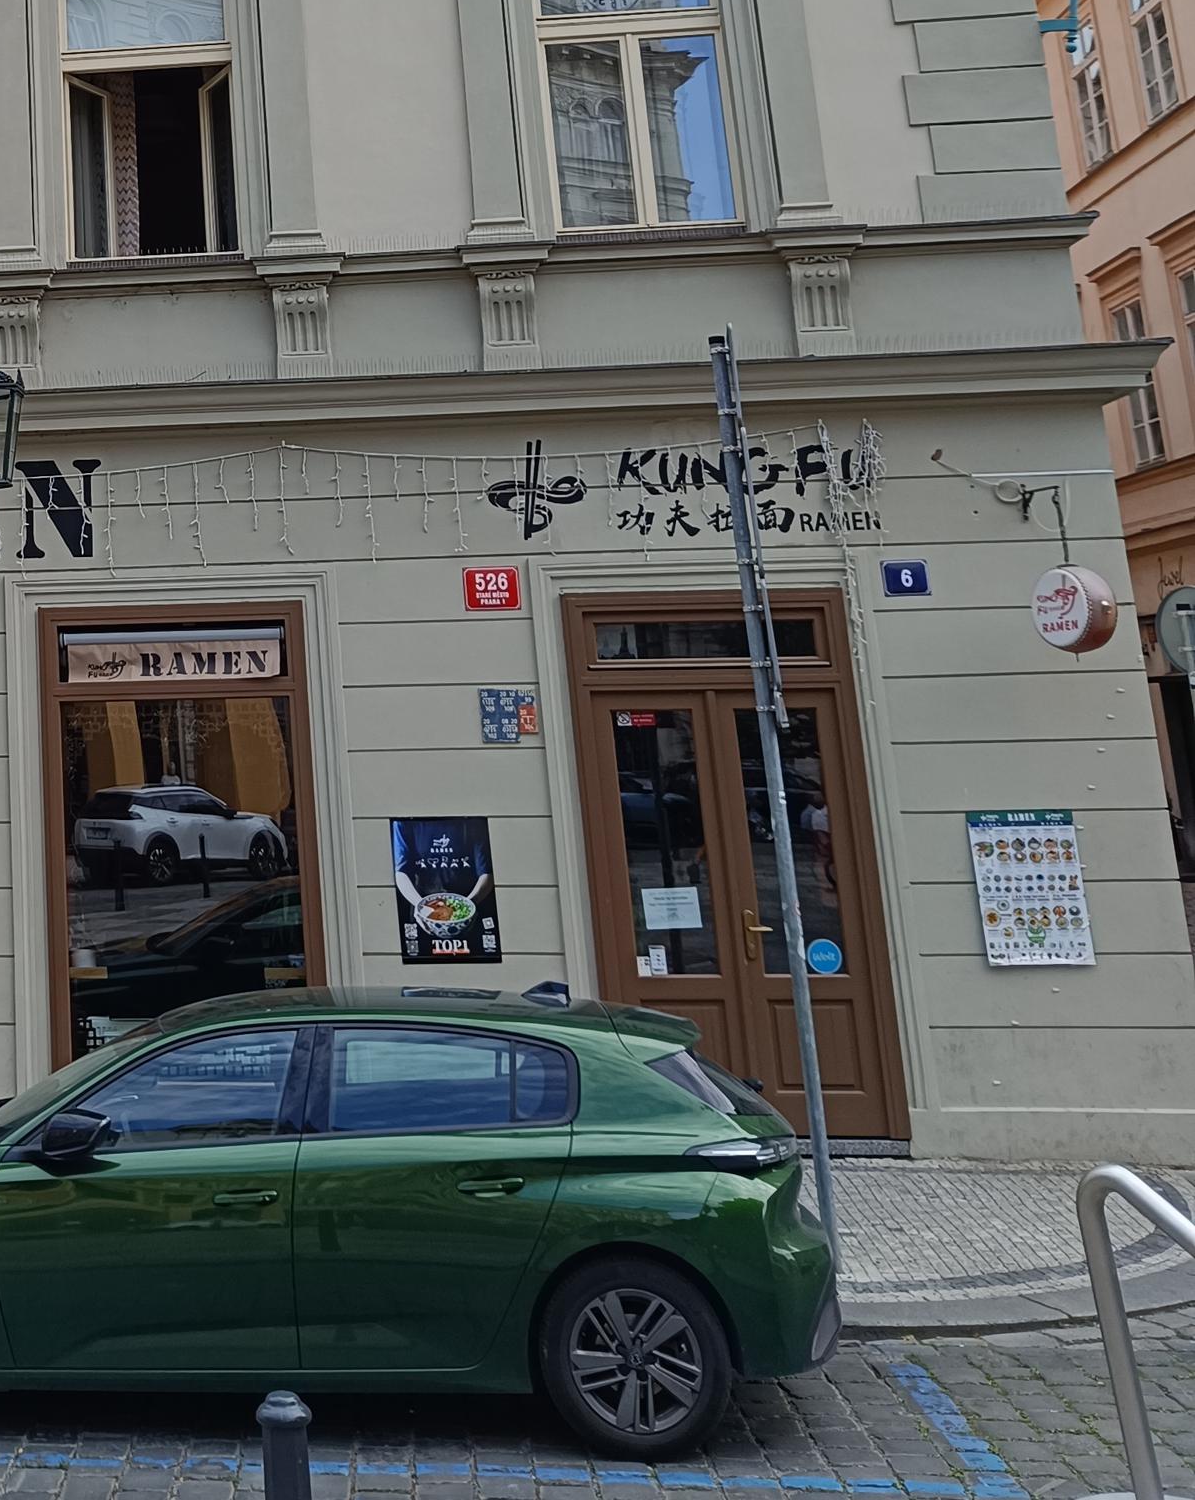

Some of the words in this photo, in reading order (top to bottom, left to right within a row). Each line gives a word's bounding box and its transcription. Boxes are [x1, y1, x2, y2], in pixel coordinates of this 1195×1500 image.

[799, 508, 883, 534] RAMEN
[475, 572, 508, 591] 526
[900, 568, 914, 588] 6
[1042, 619, 1079, 633] RAMEN
[139, 650, 268, 678] RAMEN
